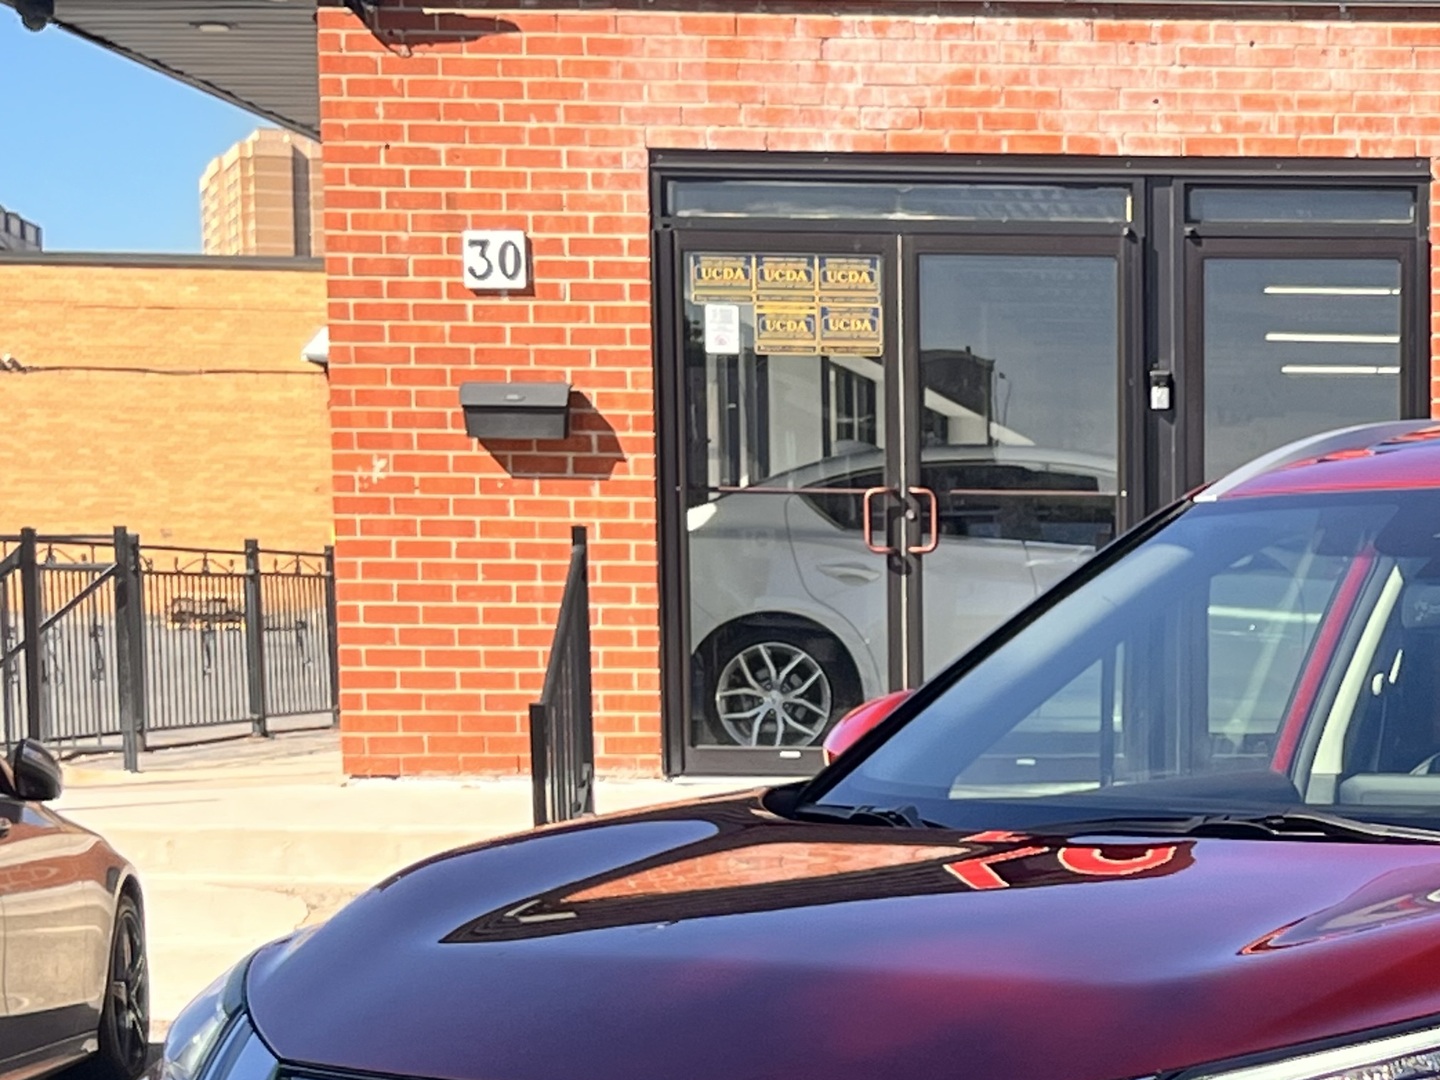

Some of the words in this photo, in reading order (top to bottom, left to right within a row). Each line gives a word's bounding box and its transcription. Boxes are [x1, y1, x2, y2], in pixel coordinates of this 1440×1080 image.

[468, 239, 522, 281] 30
[701, 267, 746, 281] UCDA
[763, 269, 808, 283] UCDA
[826, 270, 871, 284] UCDA
[765, 319, 809, 333] UCDA
[828, 318, 873, 332] UCDA
